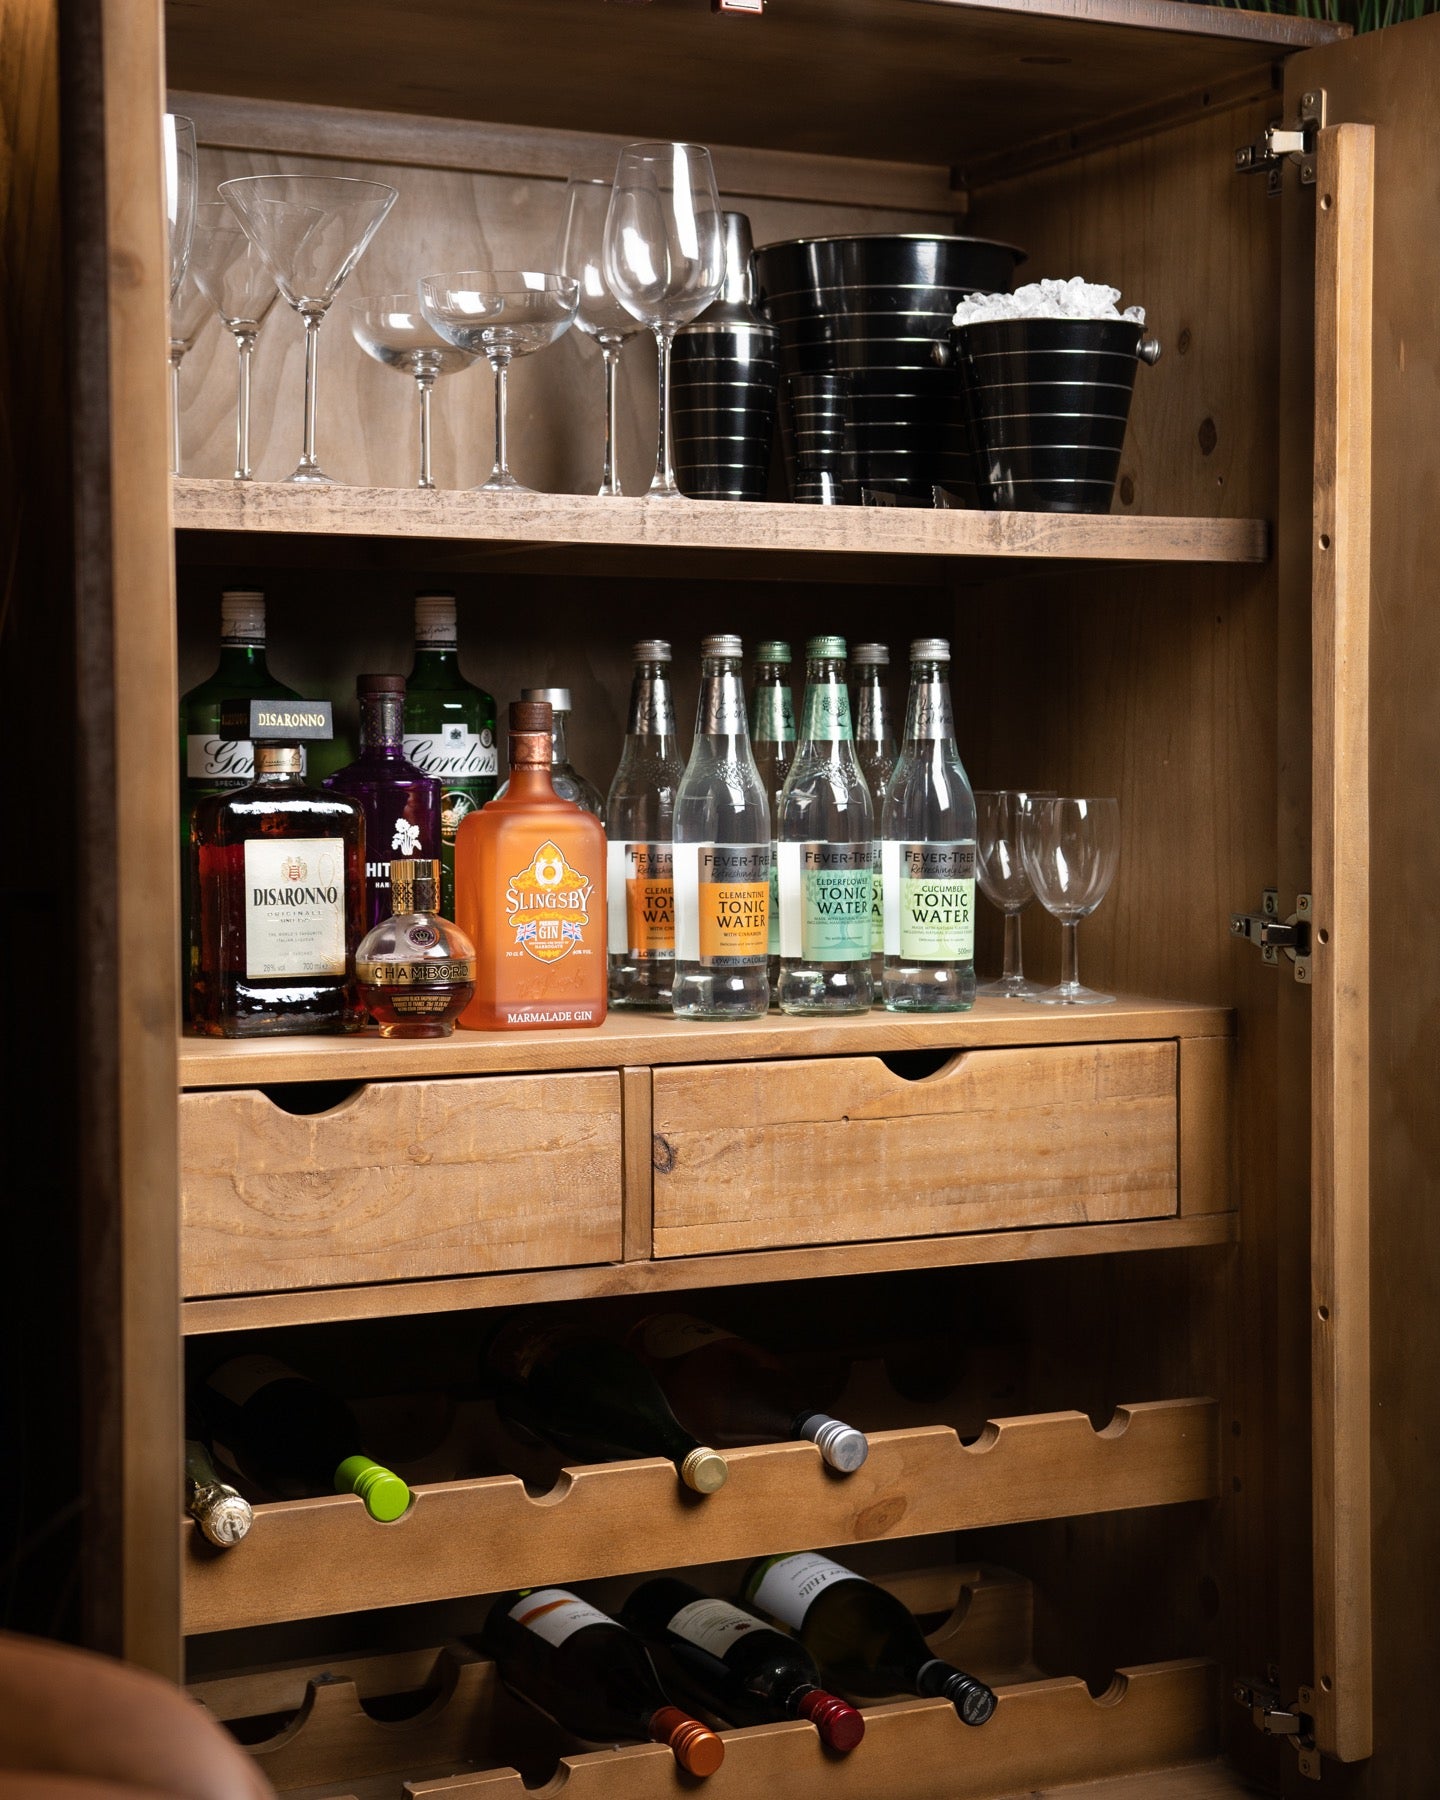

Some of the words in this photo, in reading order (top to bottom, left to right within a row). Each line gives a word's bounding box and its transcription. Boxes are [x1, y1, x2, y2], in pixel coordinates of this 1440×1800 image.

[258, 712, 325, 728] DISARONNO
[403, 740, 497, 775] Gordon's
[215, 779, 245, 788] SPECIAL
[631, 851, 673, 863] FEVER
[905, 851, 974, 863] FEVER-TREE
[644, 887, 674, 895] CLEME
[819, 887, 867, 900] TONIC
[922, 885, 964, 893] CUCUMBER
[253, 886, 338, 907] DISARONNO
[505, 885, 594, 914] SLINGSBY
[914, 893, 968, 907] TONIC
[719, 900, 765, 914] TONIC
[817, 901, 868, 915] WATER
[716, 915, 766, 928] WATER
[912, 909, 969, 923] WATER
[539, 926, 559, 940] GIN
[711, 957, 729, 965] LOW
[374, 965, 469, 980] CHAMBORD
[507, 1012, 572, 1024] MARMALADE
[574, 1011, 593, 1022] GIN
